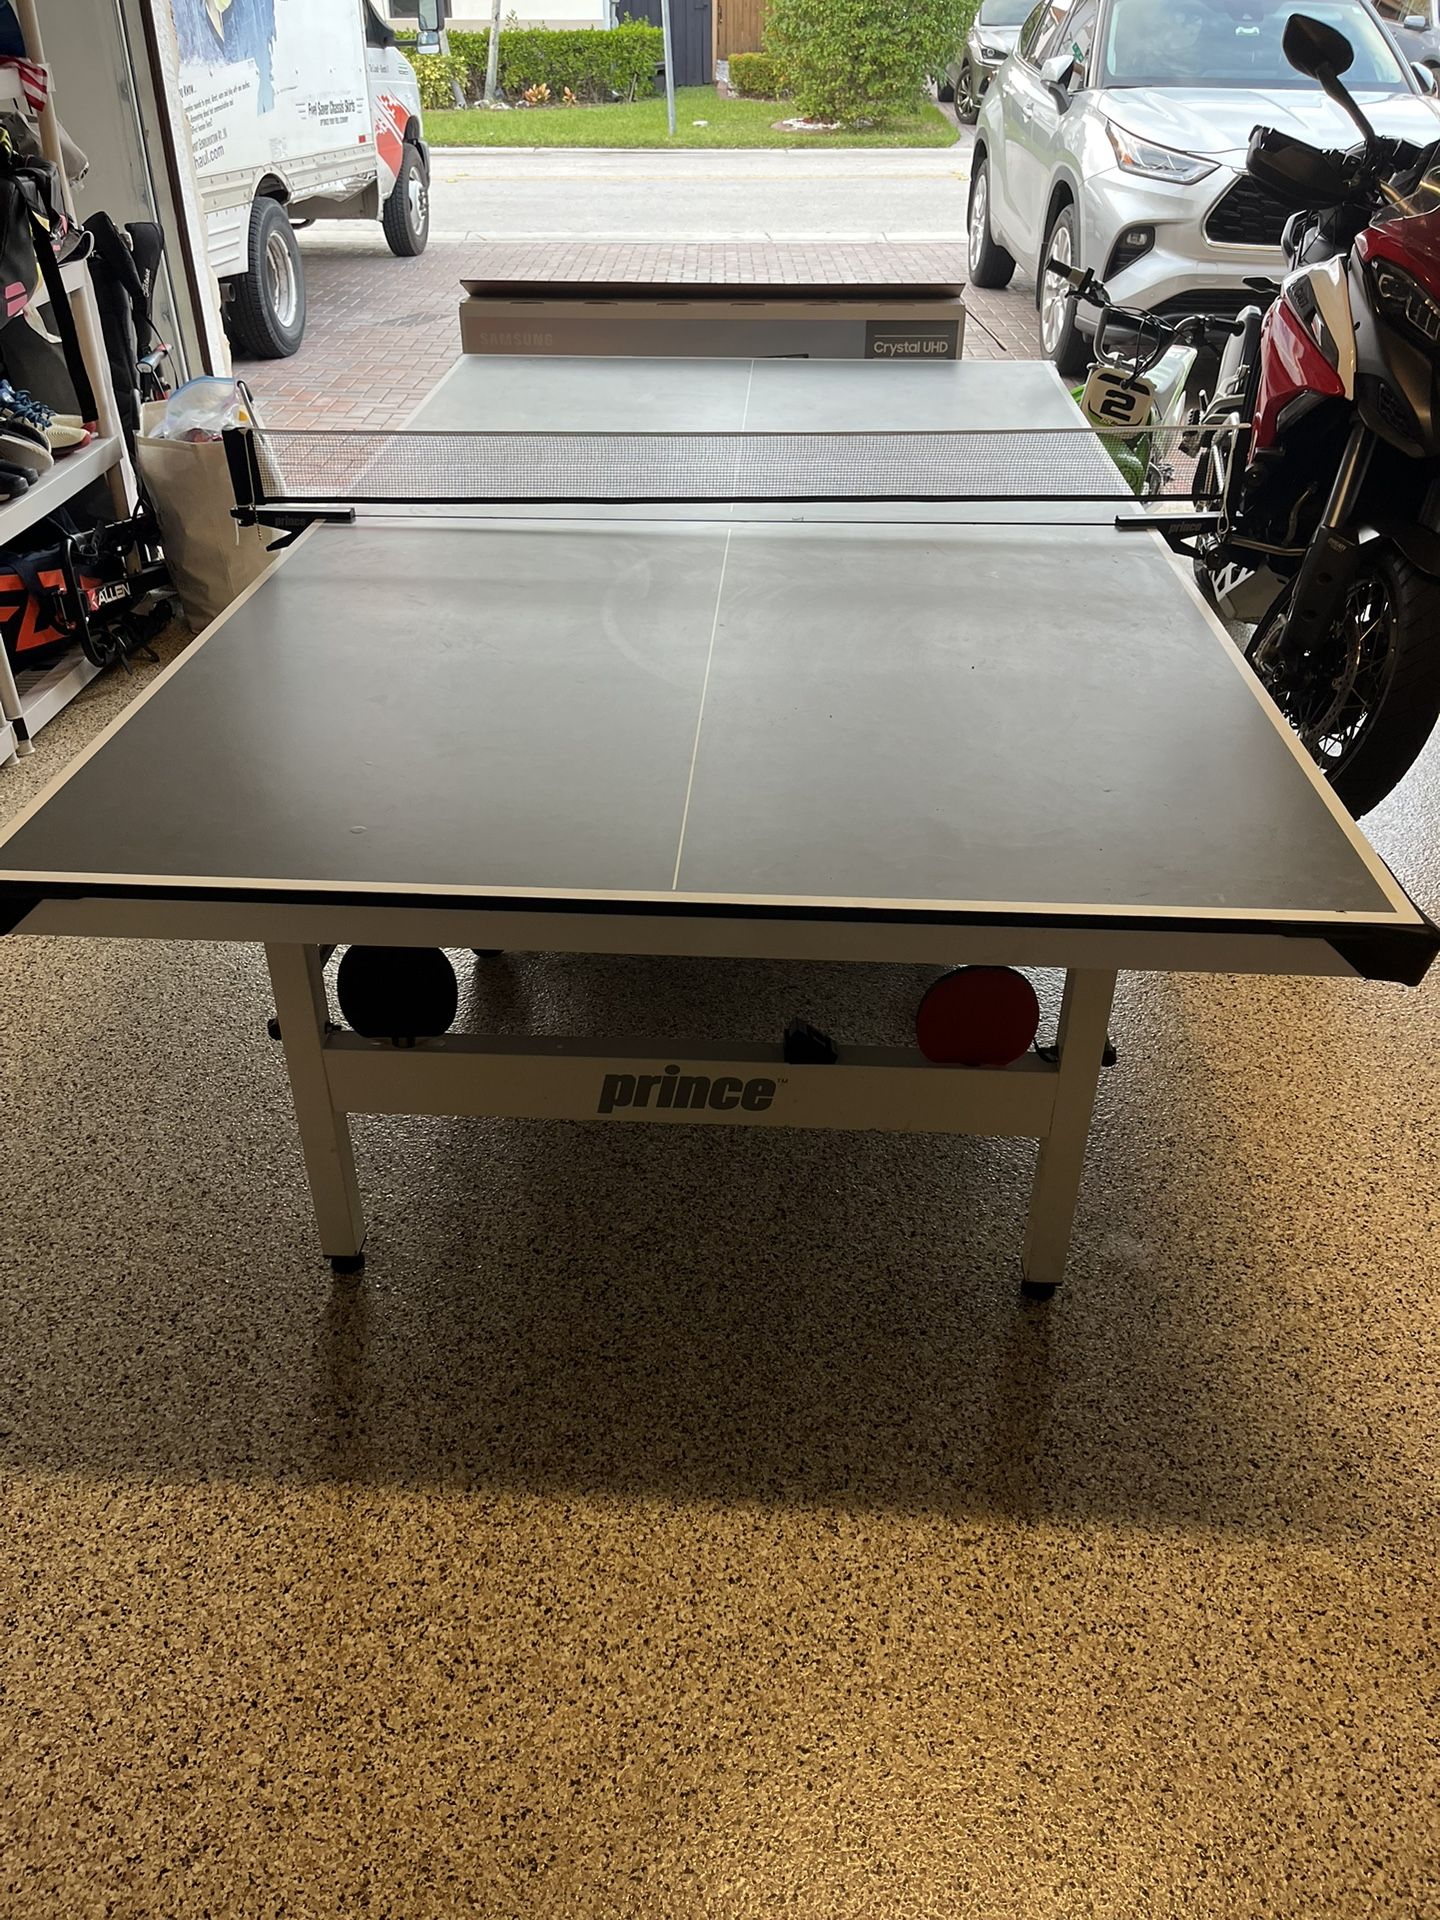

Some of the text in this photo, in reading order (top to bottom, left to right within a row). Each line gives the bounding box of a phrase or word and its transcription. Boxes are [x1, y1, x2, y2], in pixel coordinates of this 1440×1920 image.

[480, 332, 553, 347] SAMSUNG
[873, 340, 948, 357] Crystal UHD
[1100, 389, 1136, 422] 2
[99, 582, 131, 606] ALLEN
[597, 1064, 777, 1114] prince
